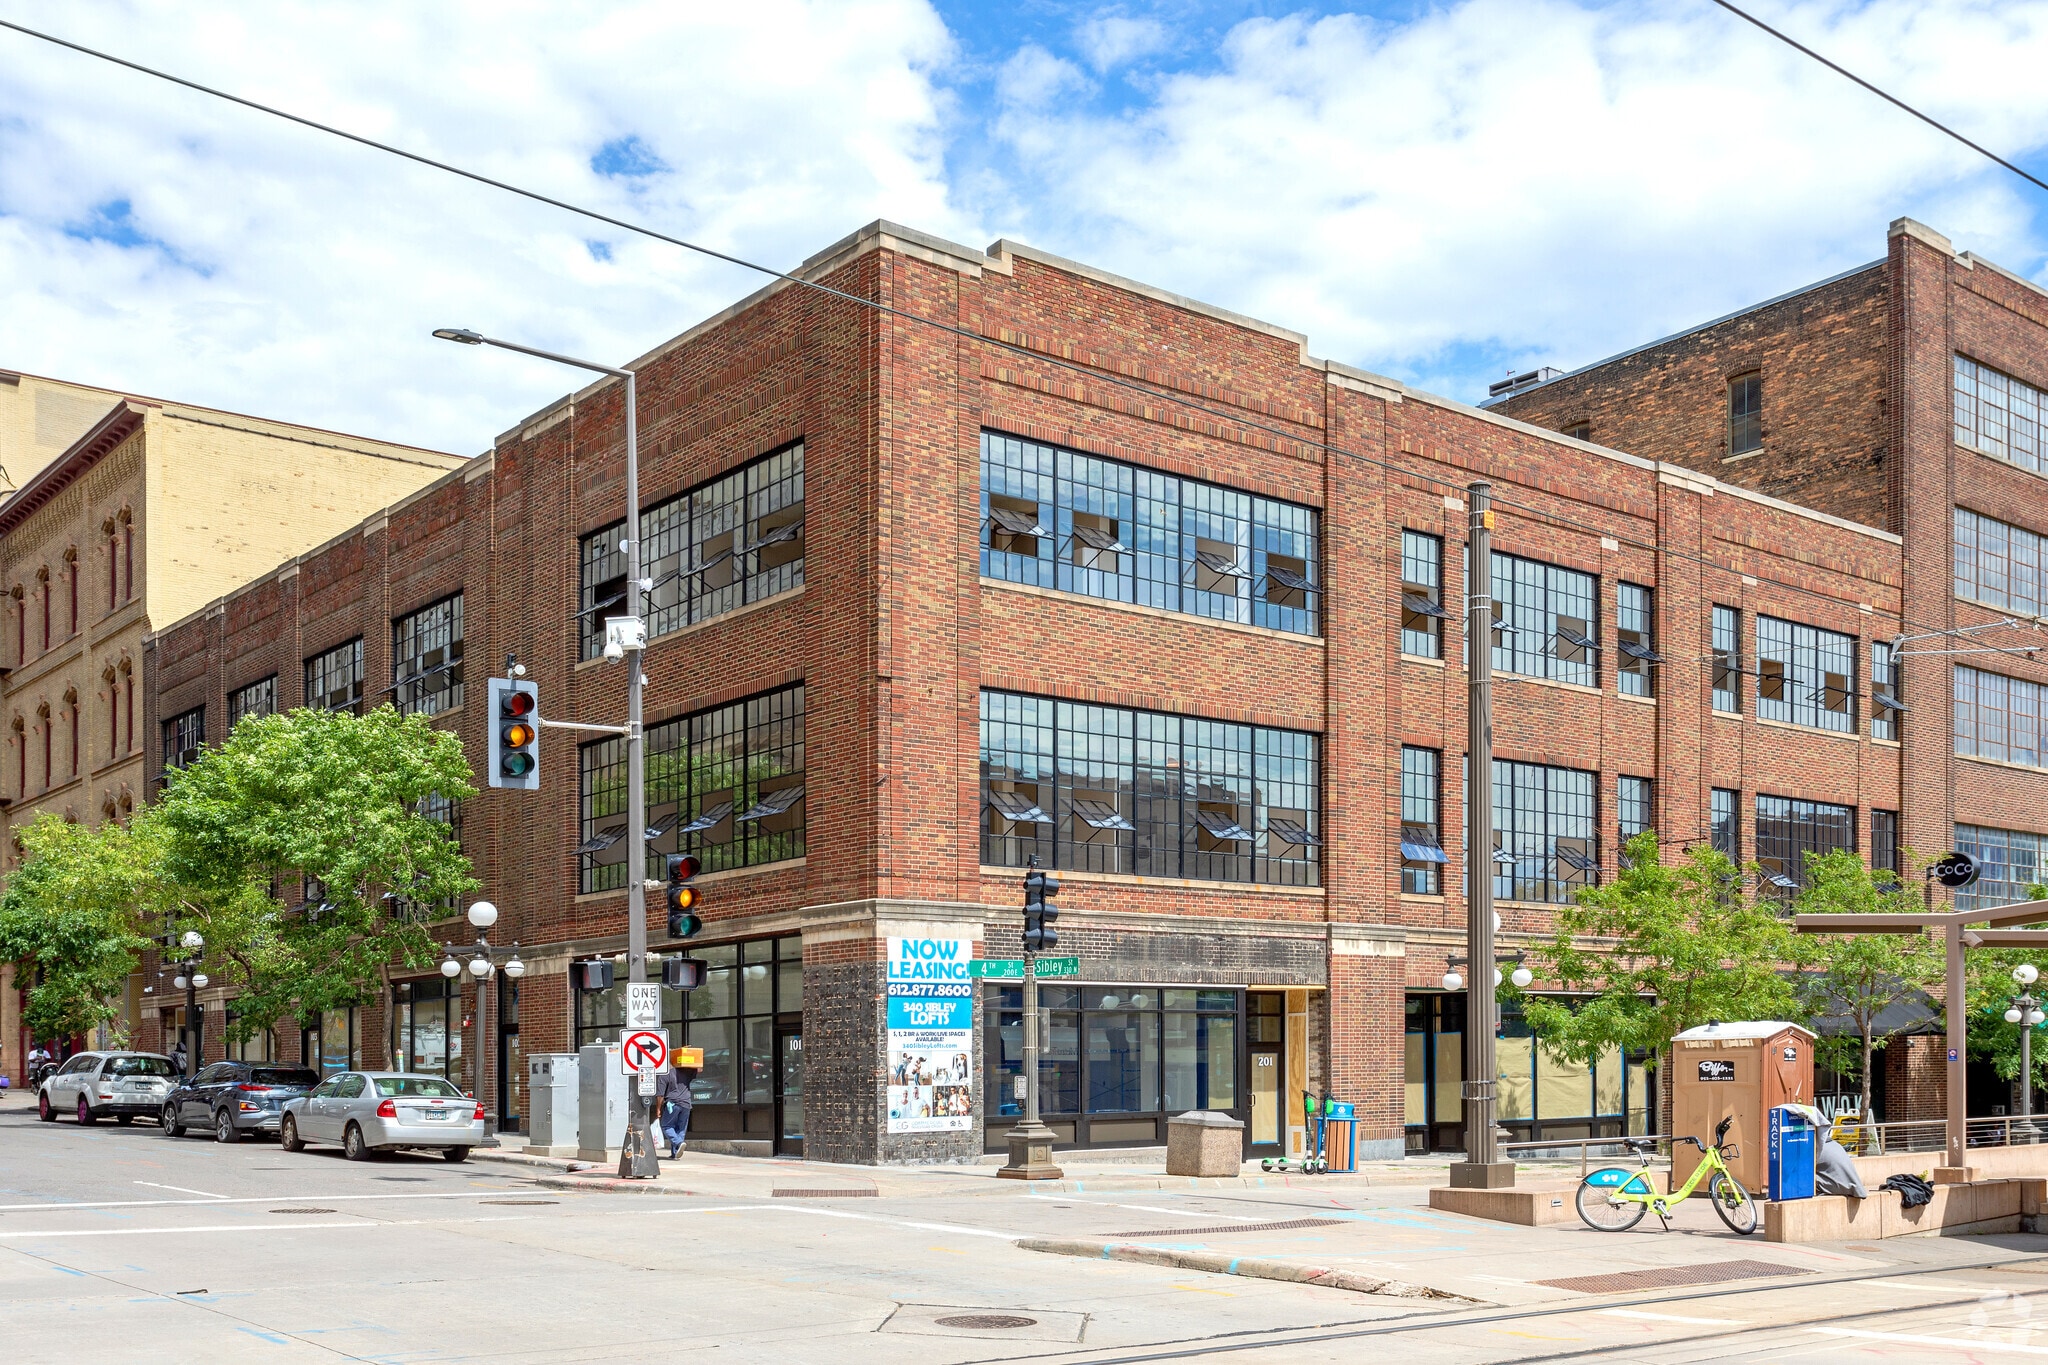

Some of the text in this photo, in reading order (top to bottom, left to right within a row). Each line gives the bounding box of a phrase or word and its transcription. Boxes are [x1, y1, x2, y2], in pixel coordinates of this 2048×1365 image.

[902, 939, 958, 960] NOW
[891, 961, 970, 979] LEASING!
[1036, 960, 1063, 975] Sibley
[632, 987, 657, 999] ONE
[888, 984, 972, 996] 612.877.8600
[631, 1000, 657, 1011] WAY
[903, 1002, 957, 1013] 340 SIBLEY
[910, 1012, 950, 1025] LOFTS
[789, 1039, 802, 1051] 101
[1258, 1056, 1273, 1067] 201
